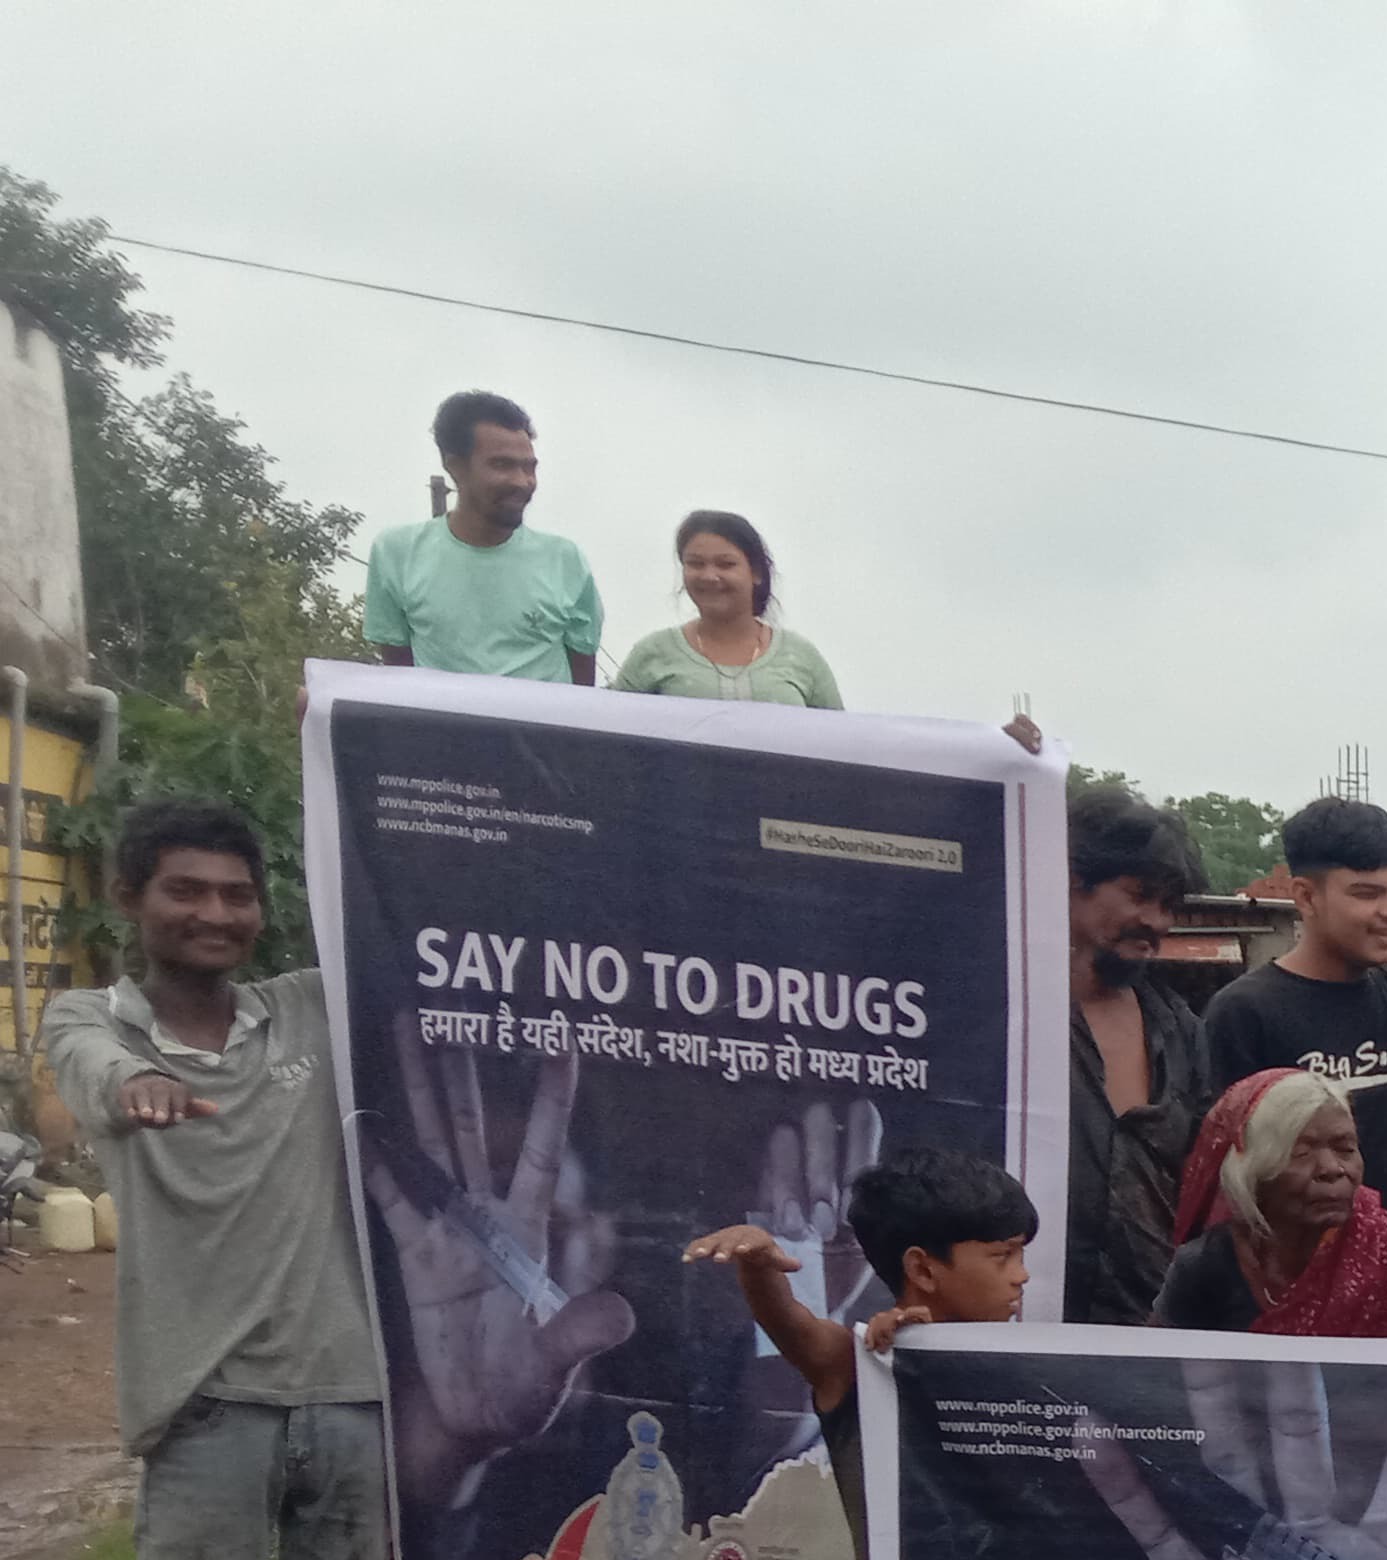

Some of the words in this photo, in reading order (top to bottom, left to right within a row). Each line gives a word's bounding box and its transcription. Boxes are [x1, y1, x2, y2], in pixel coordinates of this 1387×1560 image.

[376, 773, 501, 799] www.mppolice.gov.in
[376, 795, 594, 834] www.mppolice.gov.in/en/narcoticsmp
[376, 815, 508, 842] www.ncbmanas.gov.in
[415, 926, 526, 994] SAY
[544, 939, 629, 1004] NO
[643, 951, 718, 1015] TO
[736, 961, 928, 1039] DRUGS
[418, 1008, 491, 1045] हमारा
[496, 1001, 516, 1052] है
[521, 1009, 570, 1056] यही
[576, 1013, 653, 1067] संदेश,
[656, 1029, 770, 1082] नशा-मुक्त
[774, 1034, 802, 1081] हो
[807, 1047, 862, 1083] मध्य
[867, 1045, 929, 1090] प्रदेश
[1297, 1049, 1351, 1078] Big
[935, 1399, 1089, 1419] www.mppolice.gov.in
[938, 1420, 1206, 1445] www.mppolice.gov.in/en/narcoticsmp
[941, 1440, 1096, 1461] www.ncbmanas.gov.in
